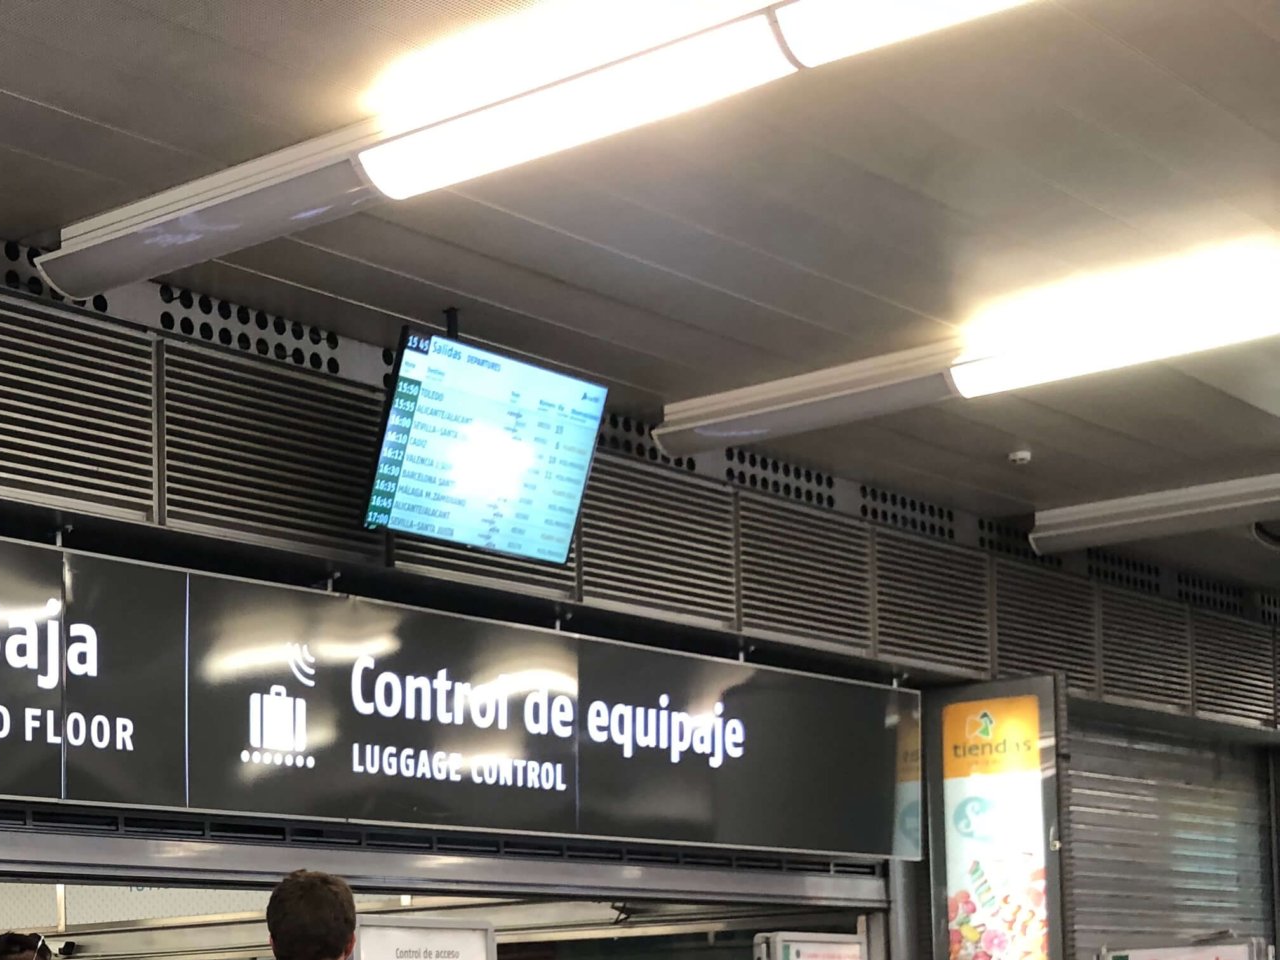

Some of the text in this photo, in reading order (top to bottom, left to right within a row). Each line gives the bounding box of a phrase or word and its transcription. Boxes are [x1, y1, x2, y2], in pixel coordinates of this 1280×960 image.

[432, 341, 462, 361] Salidas
[375, 479, 396, 493] 16:35
[372, 495, 392, 509] 16:45
[368, 511, 389, 526] 17:00
[351, 656, 745, 768] Control de equipaje
[24, 707, 135, 752] FLOOR
[352, 743, 568, 792] LUGGAGE CONTROL
[395, 947, 460, 959] Control de acceso
